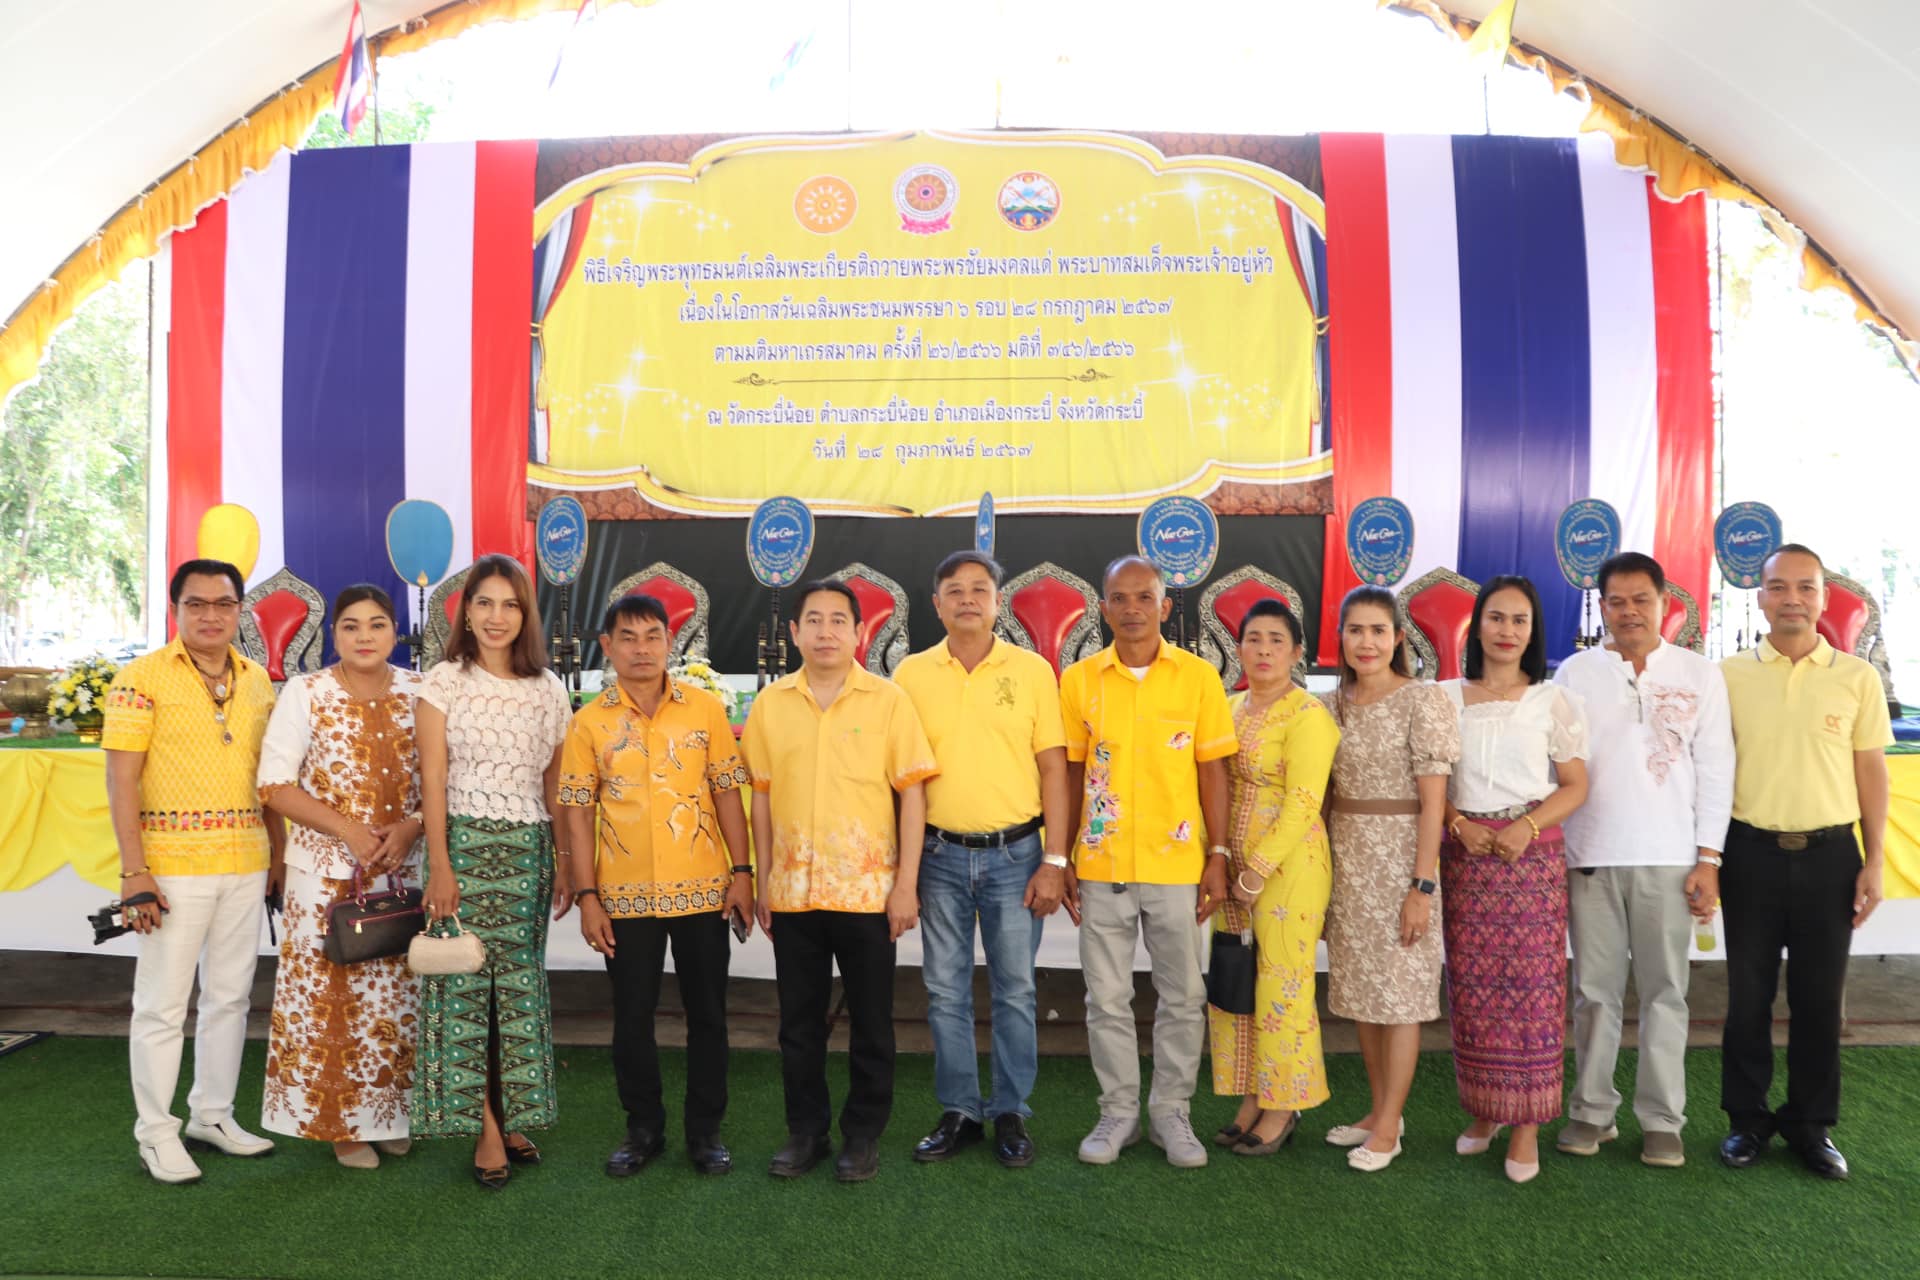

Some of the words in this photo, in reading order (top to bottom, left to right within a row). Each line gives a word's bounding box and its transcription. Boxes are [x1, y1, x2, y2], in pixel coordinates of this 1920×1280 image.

[1058, 245, 1273, 283] พระบาทสมเด็จพระเจ้าอยู่หัว
[680, 292, 952, 321] เนื่องในโอกาสวันเฉลิมพระชนมพรรษา
[958, 300, 969, 317] ๖
[976, 300, 1005, 317] รอบ
[1011, 299, 1037, 316] ๒๘
[1043, 298, 1116, 323] กรกฎาคม
[1122, 297, 1173, 315] ๒๕๖๗
[714, 338, 877, 361] ตามมติมหาเถรสมาคม
[884, 326, 922, 359] ครั้งที่
[927, 339, 1001, 360] ๒๖/๒๕๖๖
[1008, 328, 1041, 358] มติที่
[708, 409, 722, 425] ณ
[728, 397, 814, 424] วัดกระบี่น้อย
[820, 396, 928, 423] ตำบลกระบี่น้อย
[935, 395, 1051, 421] อำเภอเมืองกระบี่
[1057, 393, 1144, 420] จังหวัดกระบี่
[813, 435, 846, 459] วันที่
[896, 438, 975, 463] กุมภาพันธ์
[981, 443, 1033, 458] ๒๕๖๗
